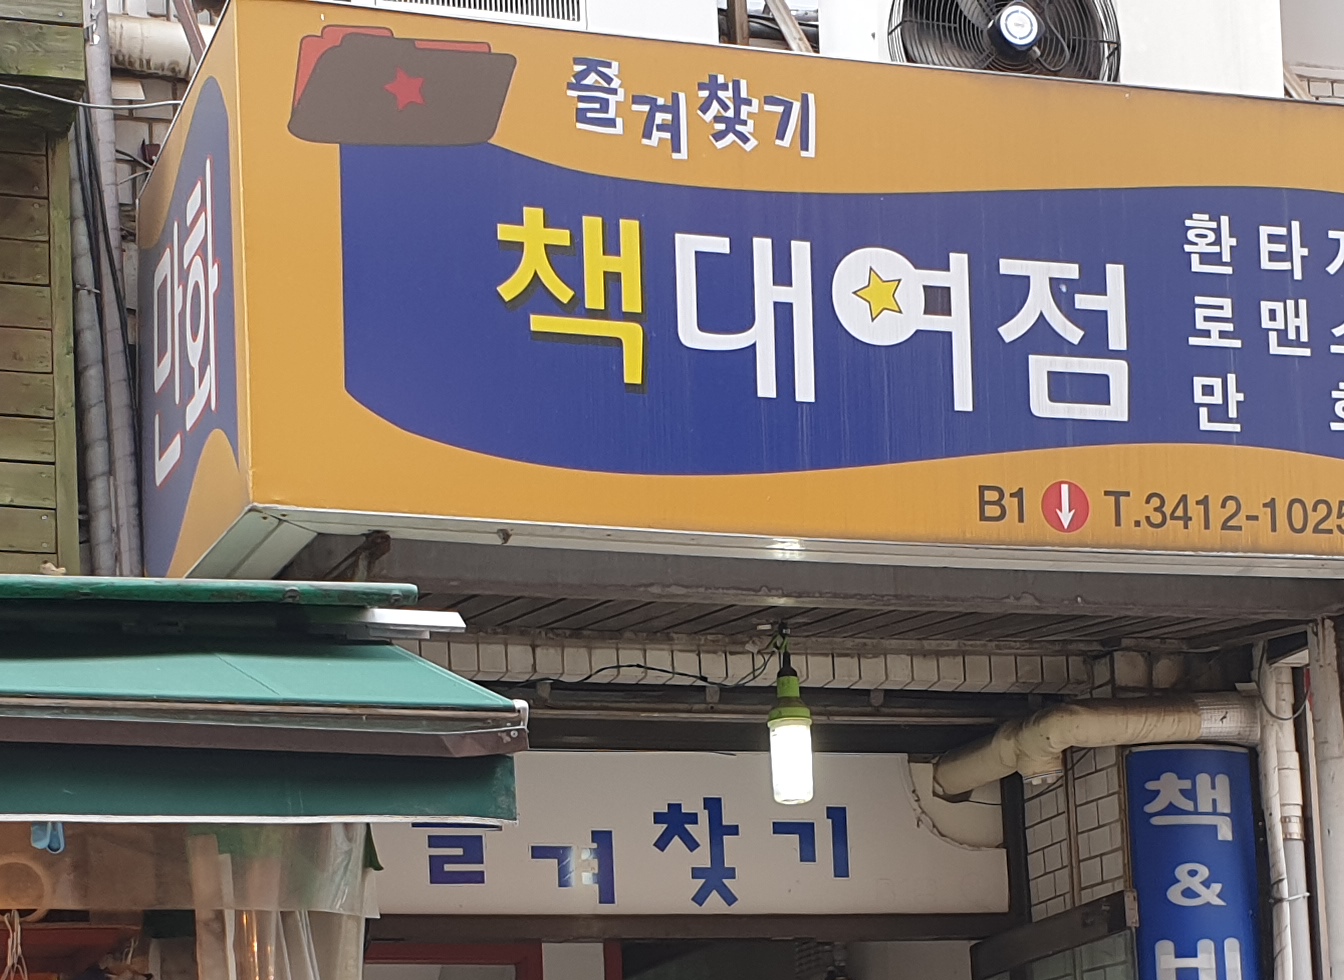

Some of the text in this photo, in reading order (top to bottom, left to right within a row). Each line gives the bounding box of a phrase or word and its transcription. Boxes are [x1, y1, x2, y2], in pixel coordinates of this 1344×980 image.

[566, 57, 817, 159] 즐겨찾기
[154, 156, 221, 487] 만화
[978, 485, 1027, 524] B1
[1143, 771, 1232, 841] 책
